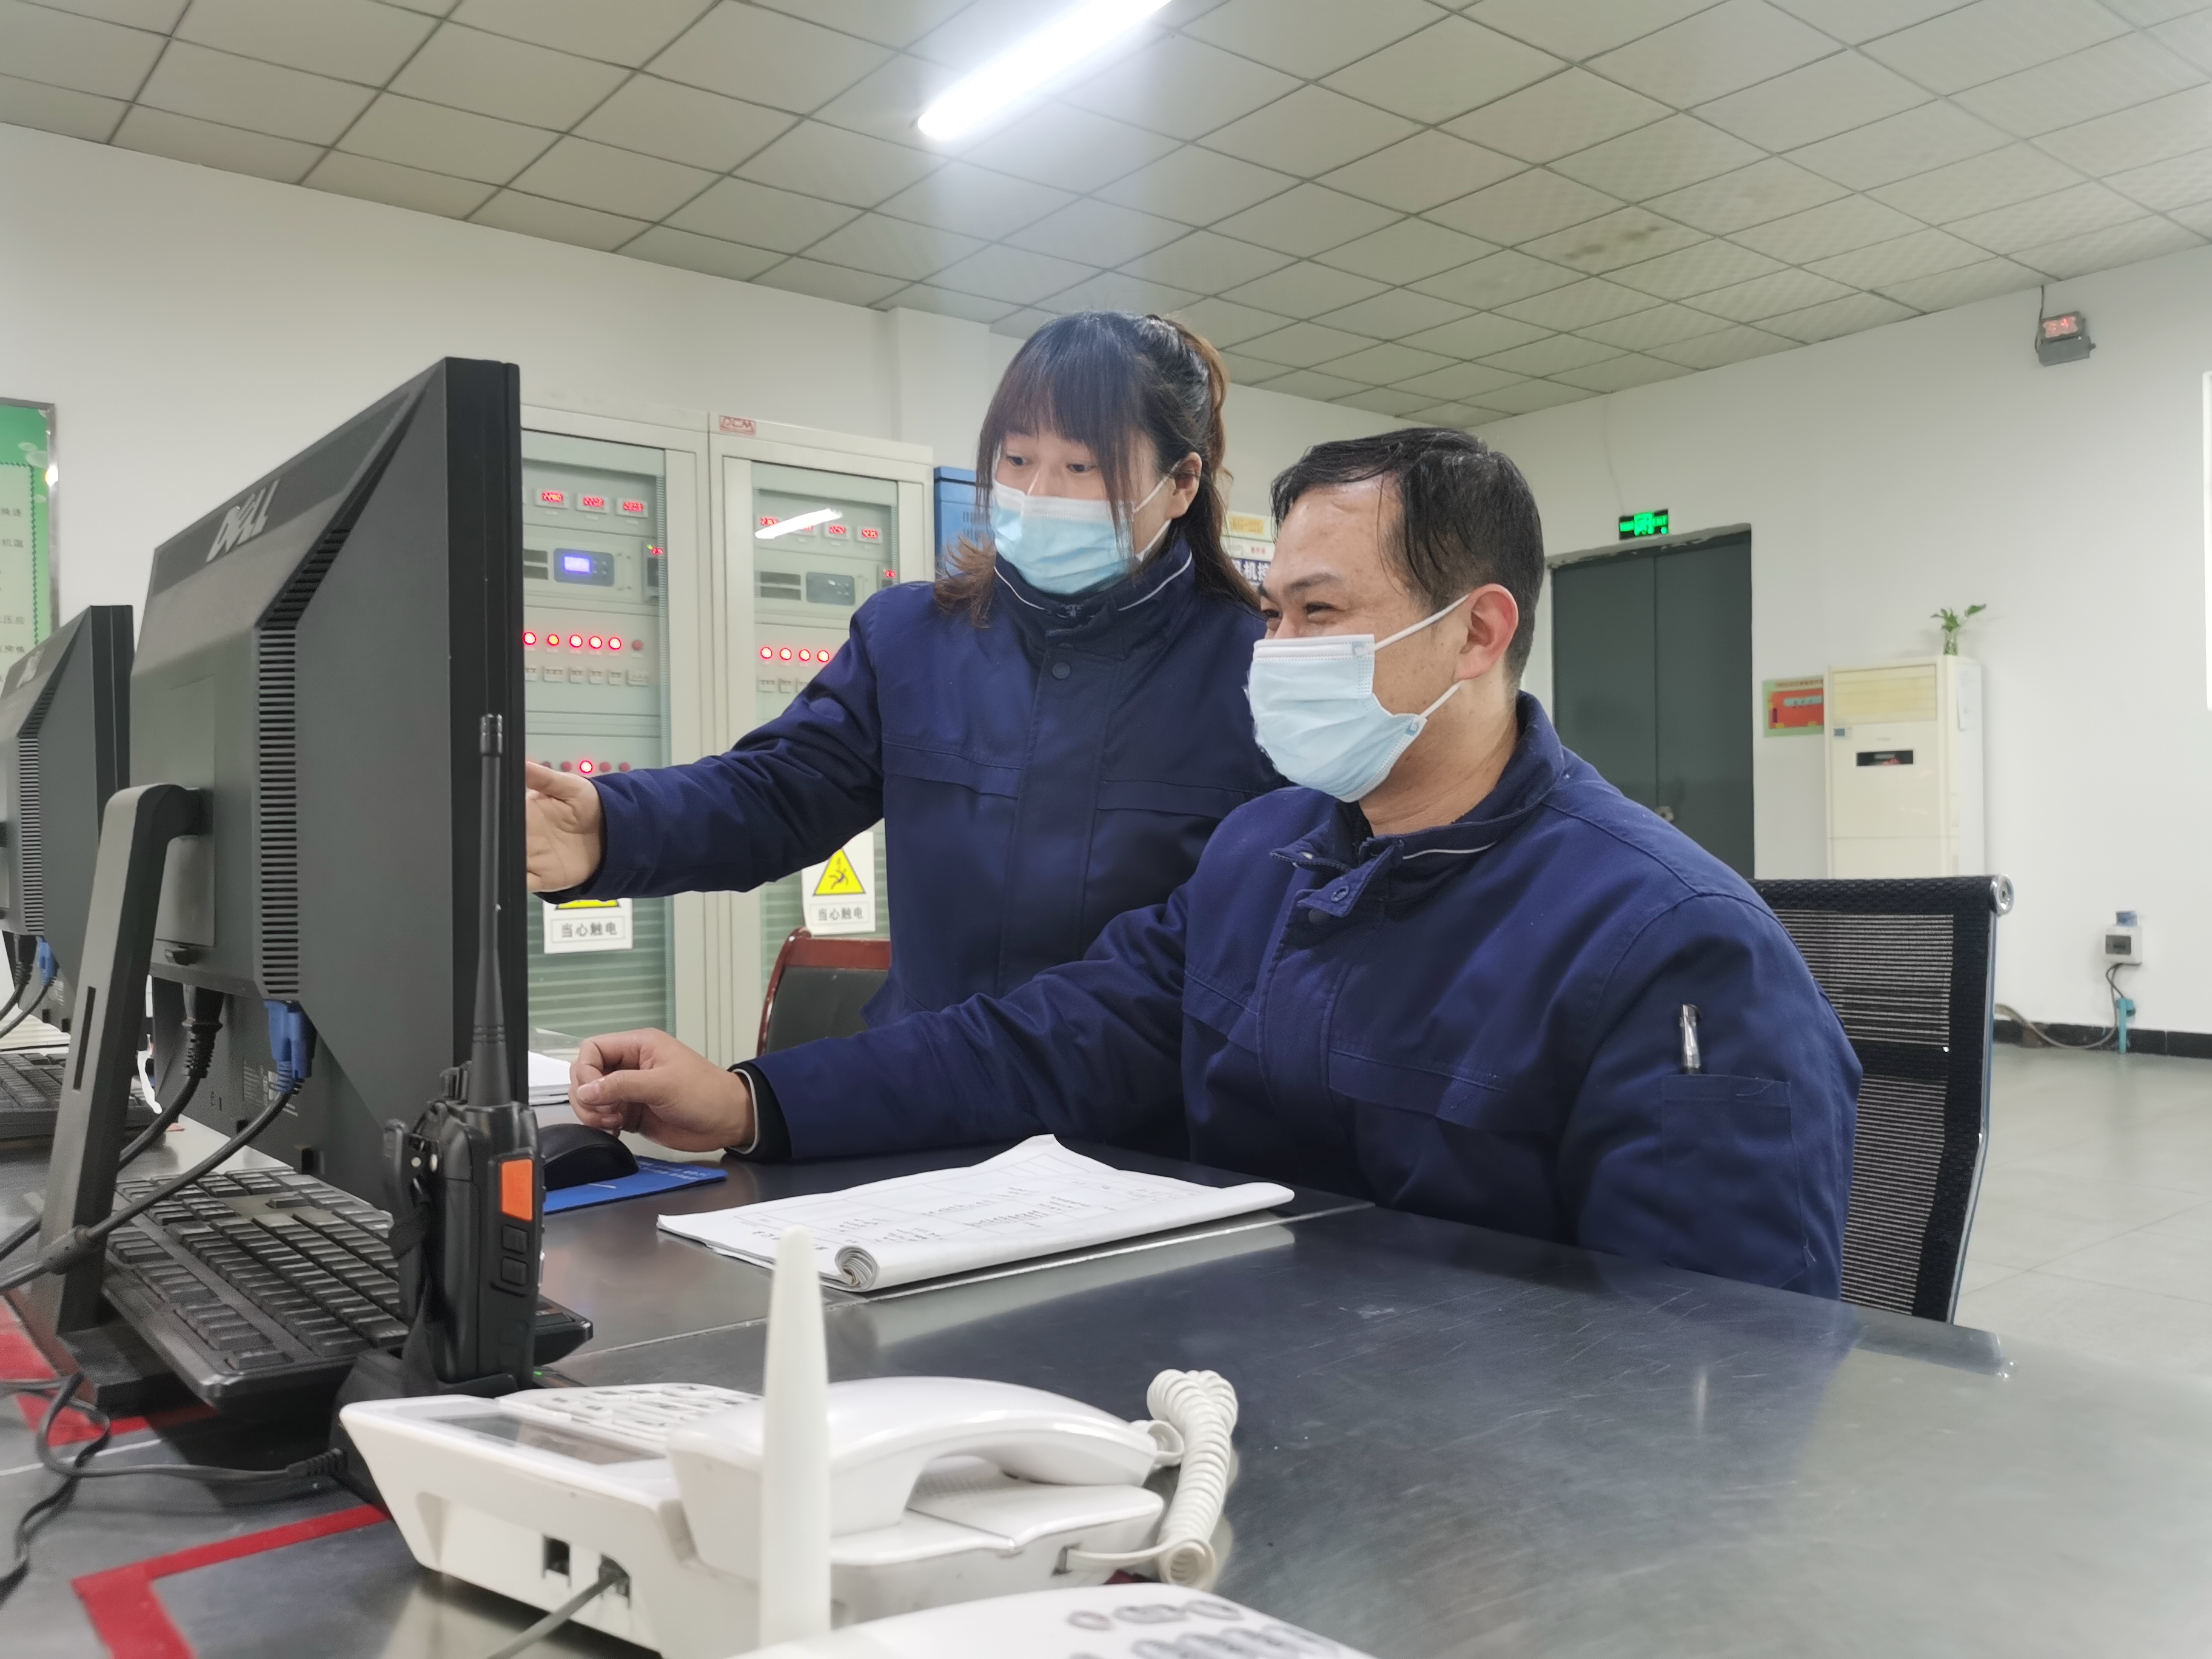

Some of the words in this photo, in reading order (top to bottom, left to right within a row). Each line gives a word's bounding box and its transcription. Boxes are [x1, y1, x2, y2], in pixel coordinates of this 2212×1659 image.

[206, 478, 280, 563] DELL
[818, 907, 863, 921] 当心触电
[561, 922, 617, 938] 当心触电
